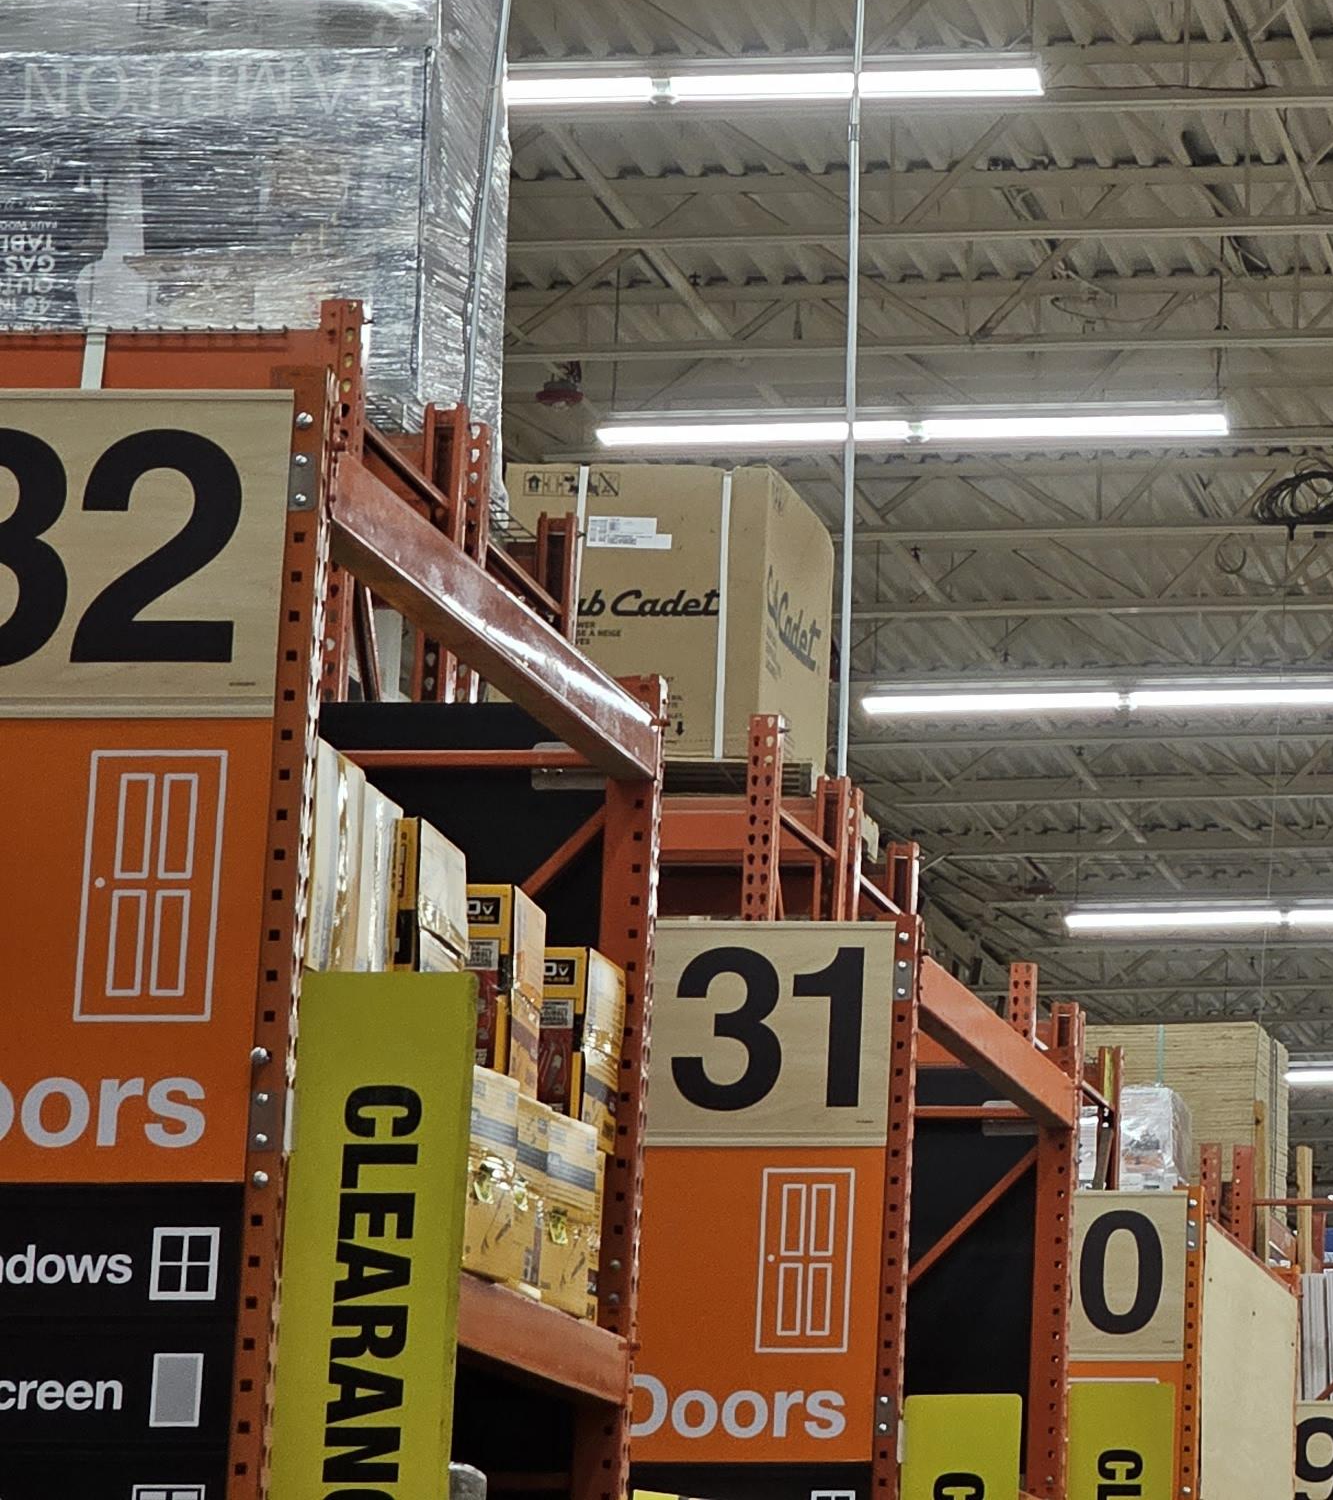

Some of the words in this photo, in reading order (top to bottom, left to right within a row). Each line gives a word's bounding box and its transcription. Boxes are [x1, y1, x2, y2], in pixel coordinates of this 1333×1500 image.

[4, 254, 56, 272] GAS
[610, 589, 720, 617] Cadet
[671, 946, 867, 1111] 31
[0, 1077, 206, 1149] ors
[0, 1244, 133, 1285] dows
[322, 1084, 422, 1500] CLEARAN
[629, 1373, 847, 1439] Doors
